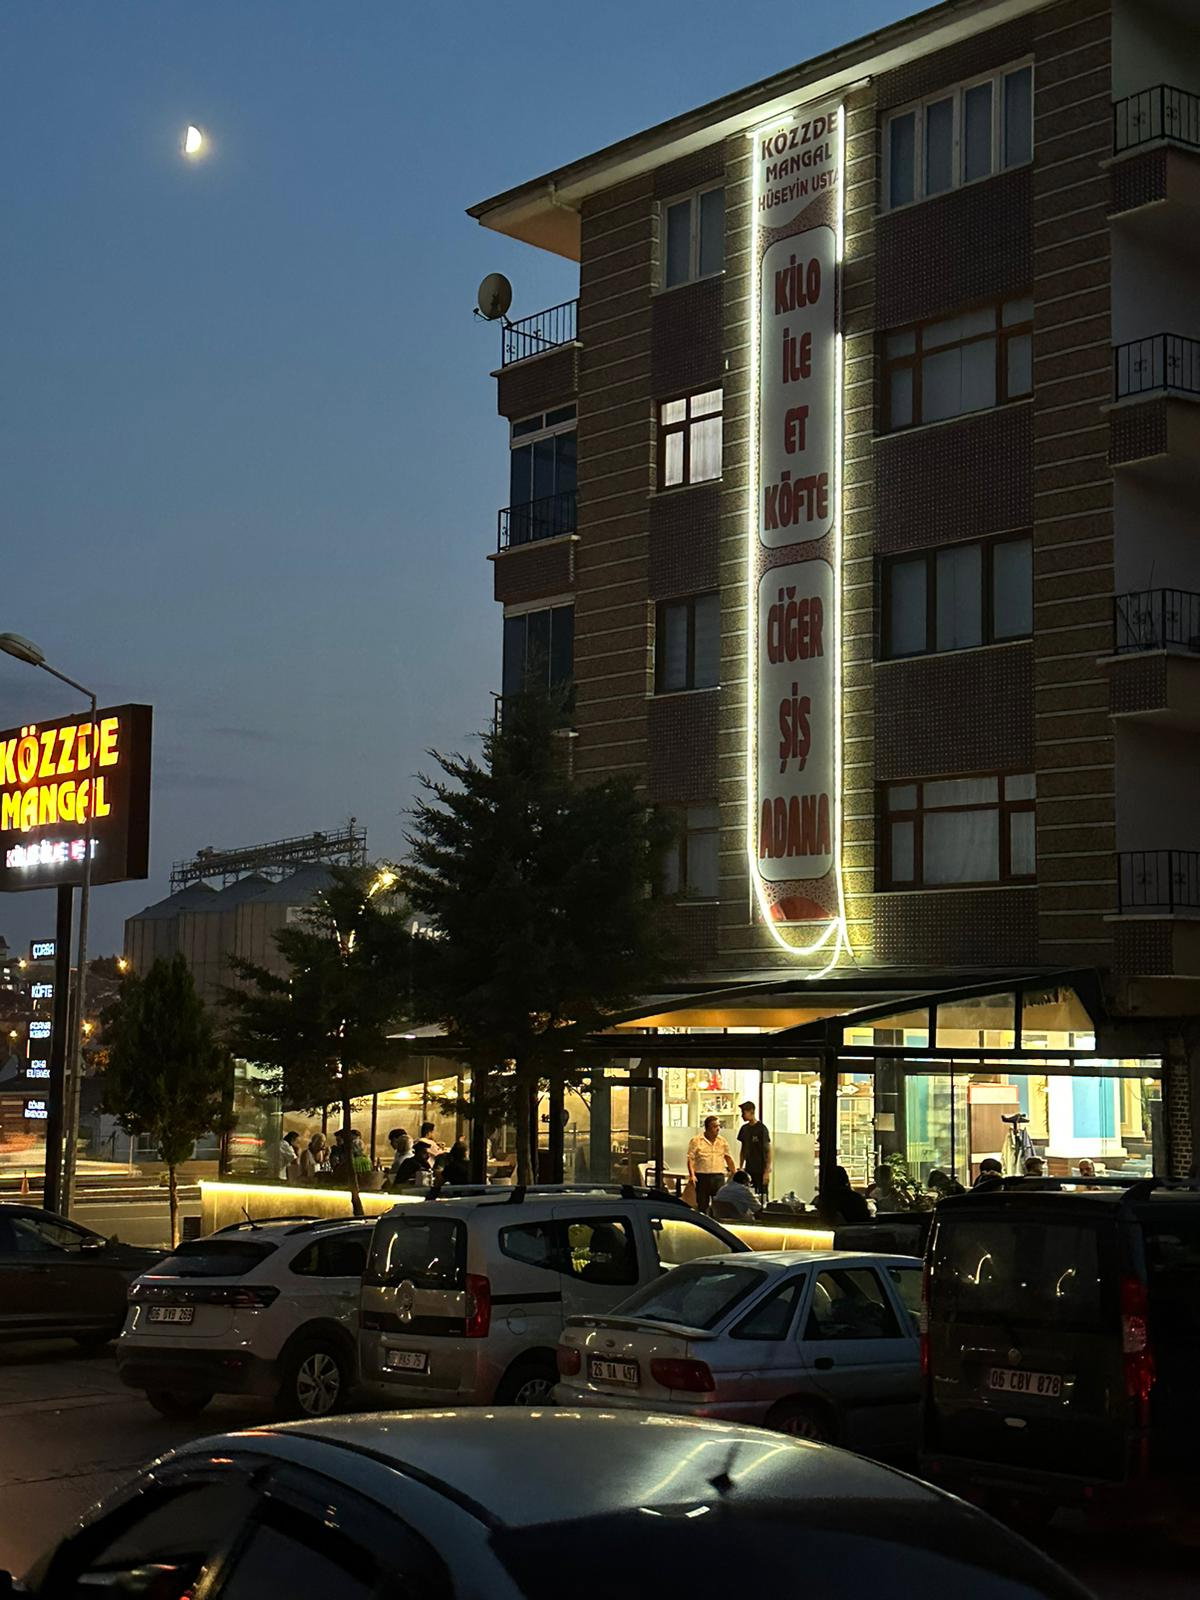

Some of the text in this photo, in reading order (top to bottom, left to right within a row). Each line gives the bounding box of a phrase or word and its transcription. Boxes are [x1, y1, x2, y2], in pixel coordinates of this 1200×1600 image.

[761, 110, 838, 160] KÖZZDE
[766, 142, 833, 183] MANGAL
[757, 178, 809, 212] HÜSEYİN
[774, 253, 821, 316] KİLO
[782, 327, 812, 385] İLE
[784, 404, 810, 455] ET
[764, 470, 829, 531] KÖFTE
[767, 585, 824, 664] CİĞER
[0, 716, 119, 785] KÖZZDE
[779, 681, 811, 774] ŞİŞ
[1, 775, 111, 832] MANGAL
[759, 792, 830, 859] ADANA
